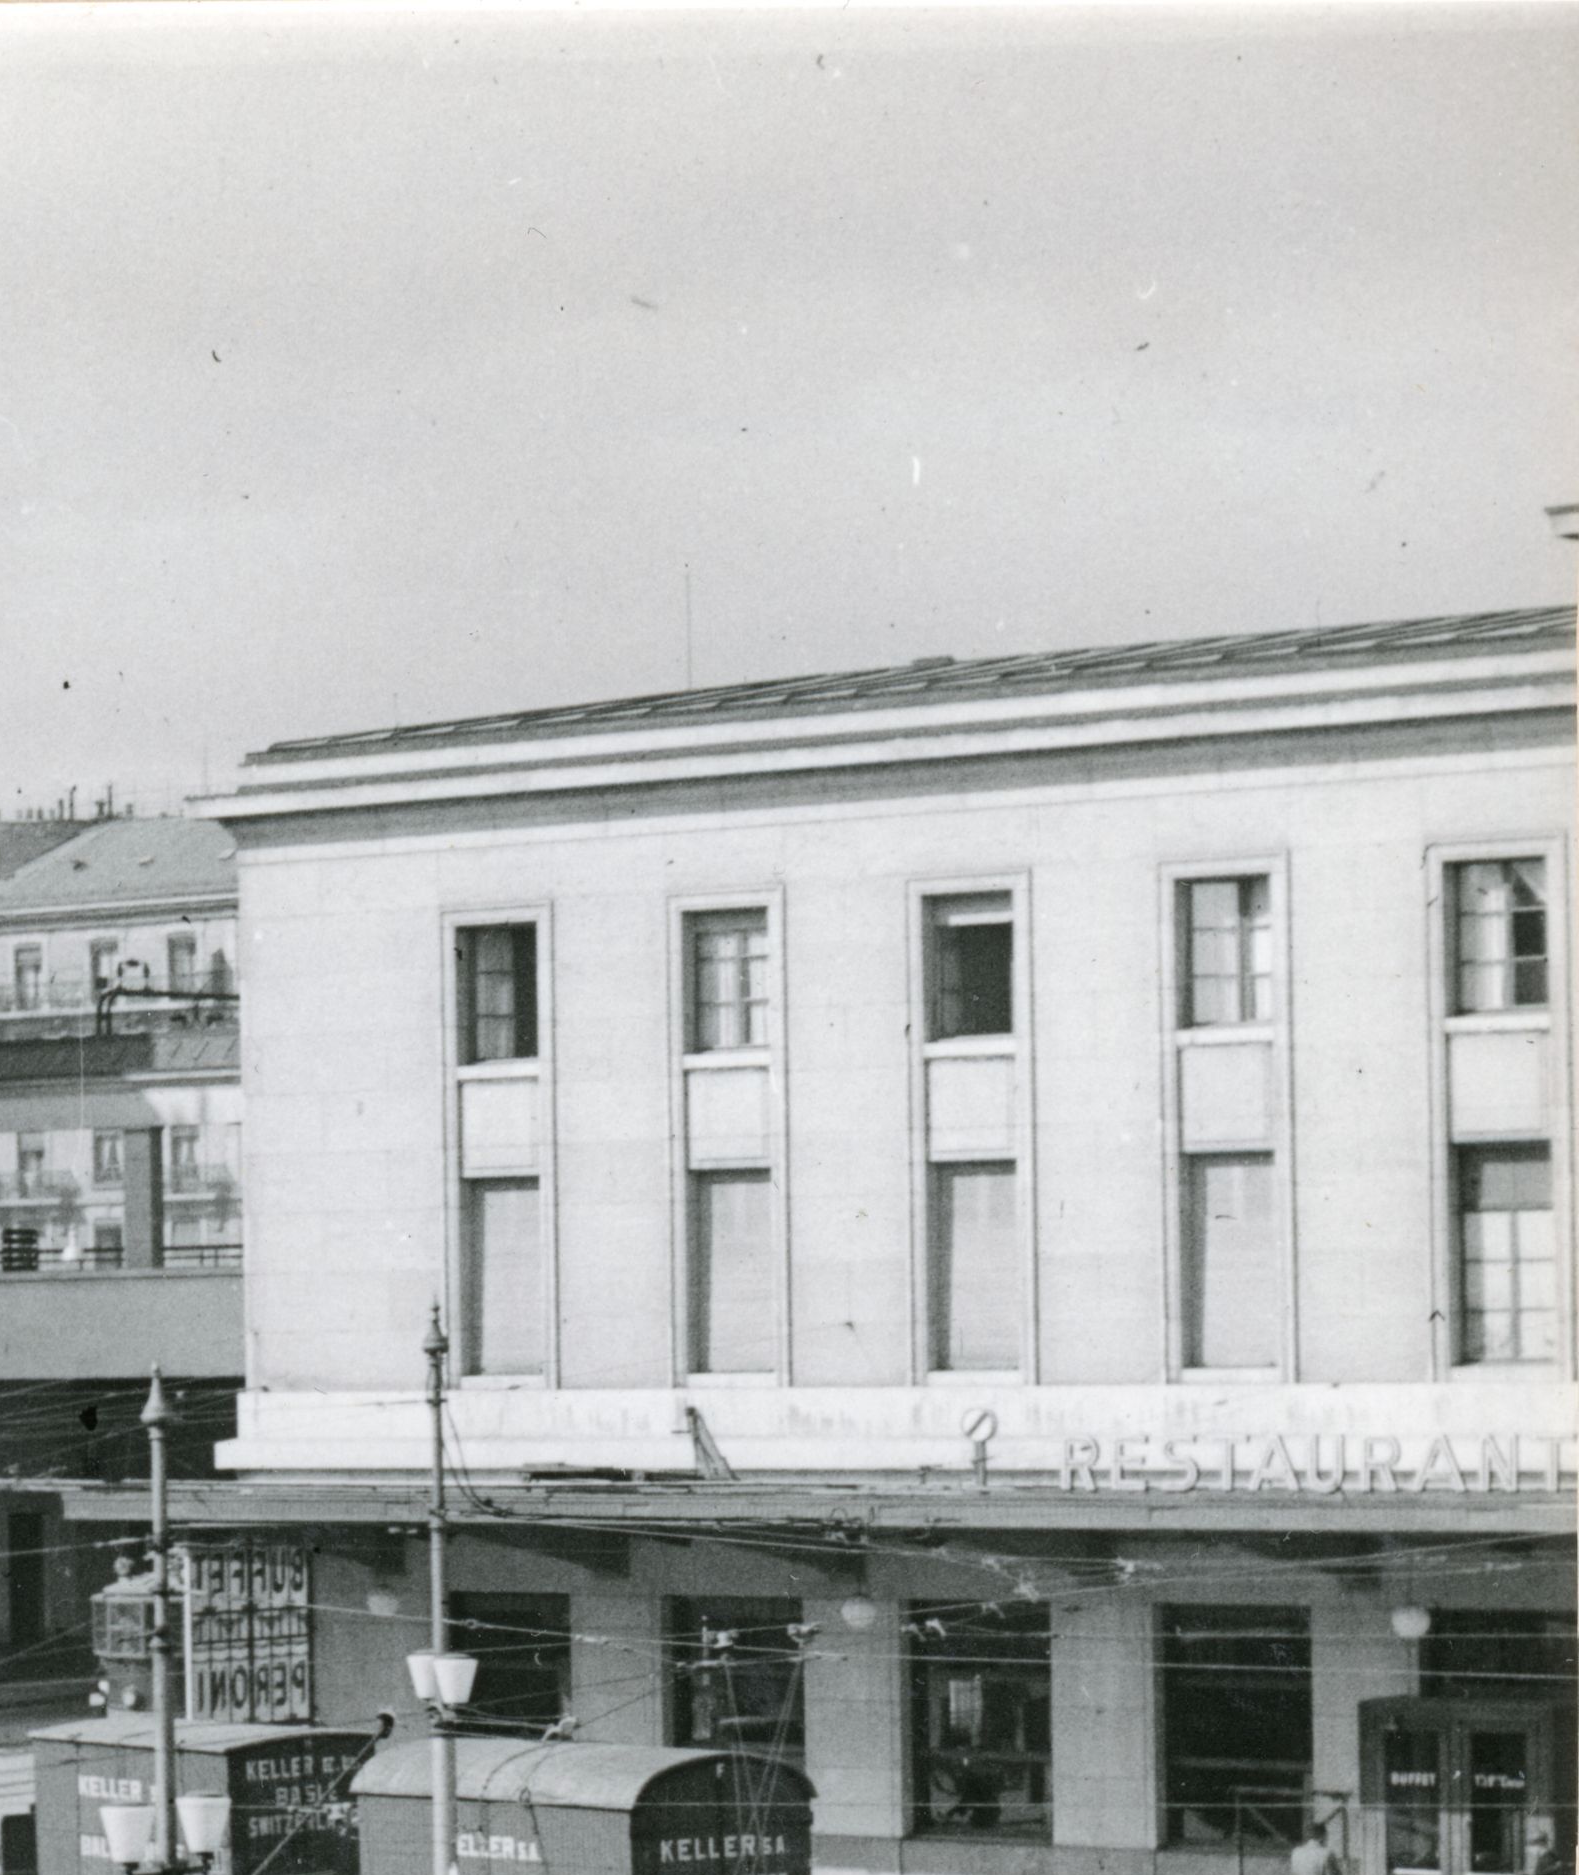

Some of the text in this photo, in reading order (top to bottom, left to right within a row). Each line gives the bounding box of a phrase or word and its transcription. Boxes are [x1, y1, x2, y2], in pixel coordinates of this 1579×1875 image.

[1057, 1432, 1576, 1494] RESTAURANT
[245, 1755, 314, 1781] KELLER
[78, 1774, 142, 1801] KELLER
[456, 1833, 514, 1860] ELLER
[660, 1834, 755, 1863] KELLER
